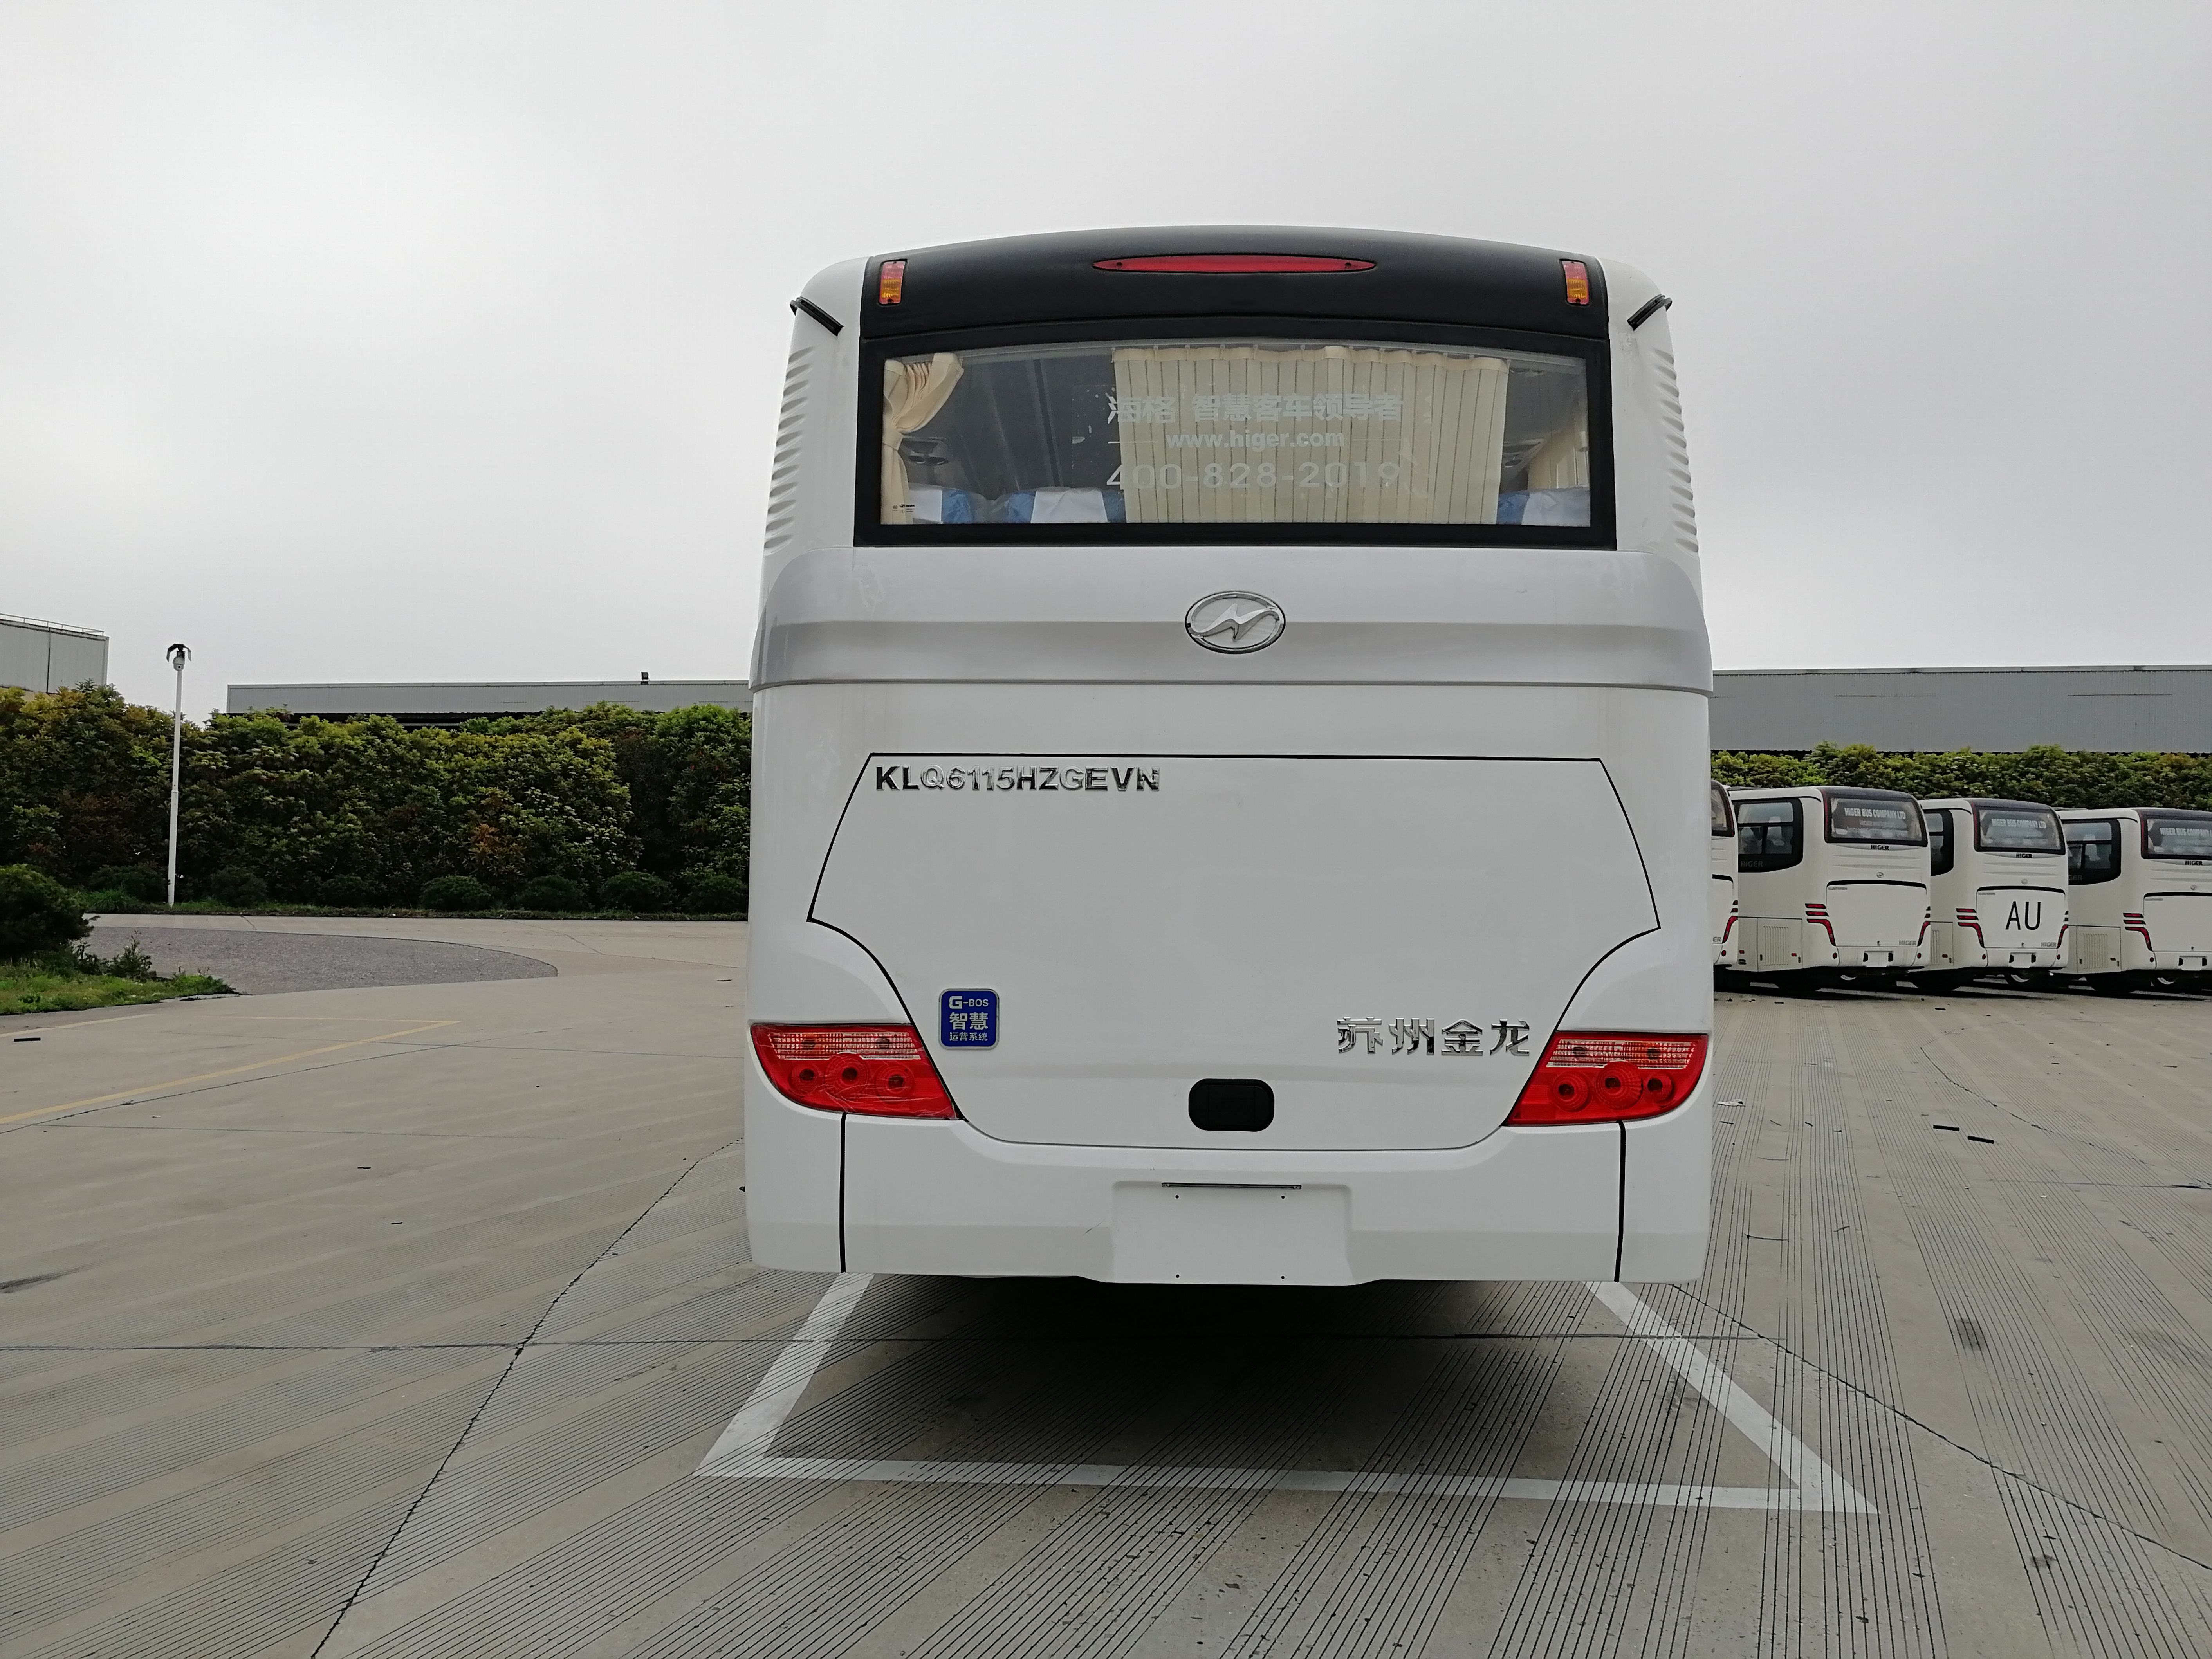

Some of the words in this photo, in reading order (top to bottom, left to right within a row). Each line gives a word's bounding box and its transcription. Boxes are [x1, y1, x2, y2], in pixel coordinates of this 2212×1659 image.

[1107, 393, 1175, 424] 海格
[1193, 393, 1404, 422] 智慧客车领导者
[1166, 429, 1345, 452] www.higer.com
[1106, 462, 1401, 490] 400-828-2019
[876, 764, 1160, 791] KLQ6115HZGEVN
[1844, 808, 1861, 816] HIGER
[1861, 808, 1873, 817] BUS
[1873, 809, 1897, 819] COMPANY
[1897, 811, 1906, 819] LTD
[2005, 901, 2041, 930] AU
[949, 996, 989, 1009] G-BOS
[949, 1012, 988, 1030] 智慧
[949, 1032, 988, 1041] 运营系统
[1337, 1017, 1530, 1056] 苏州金龙
